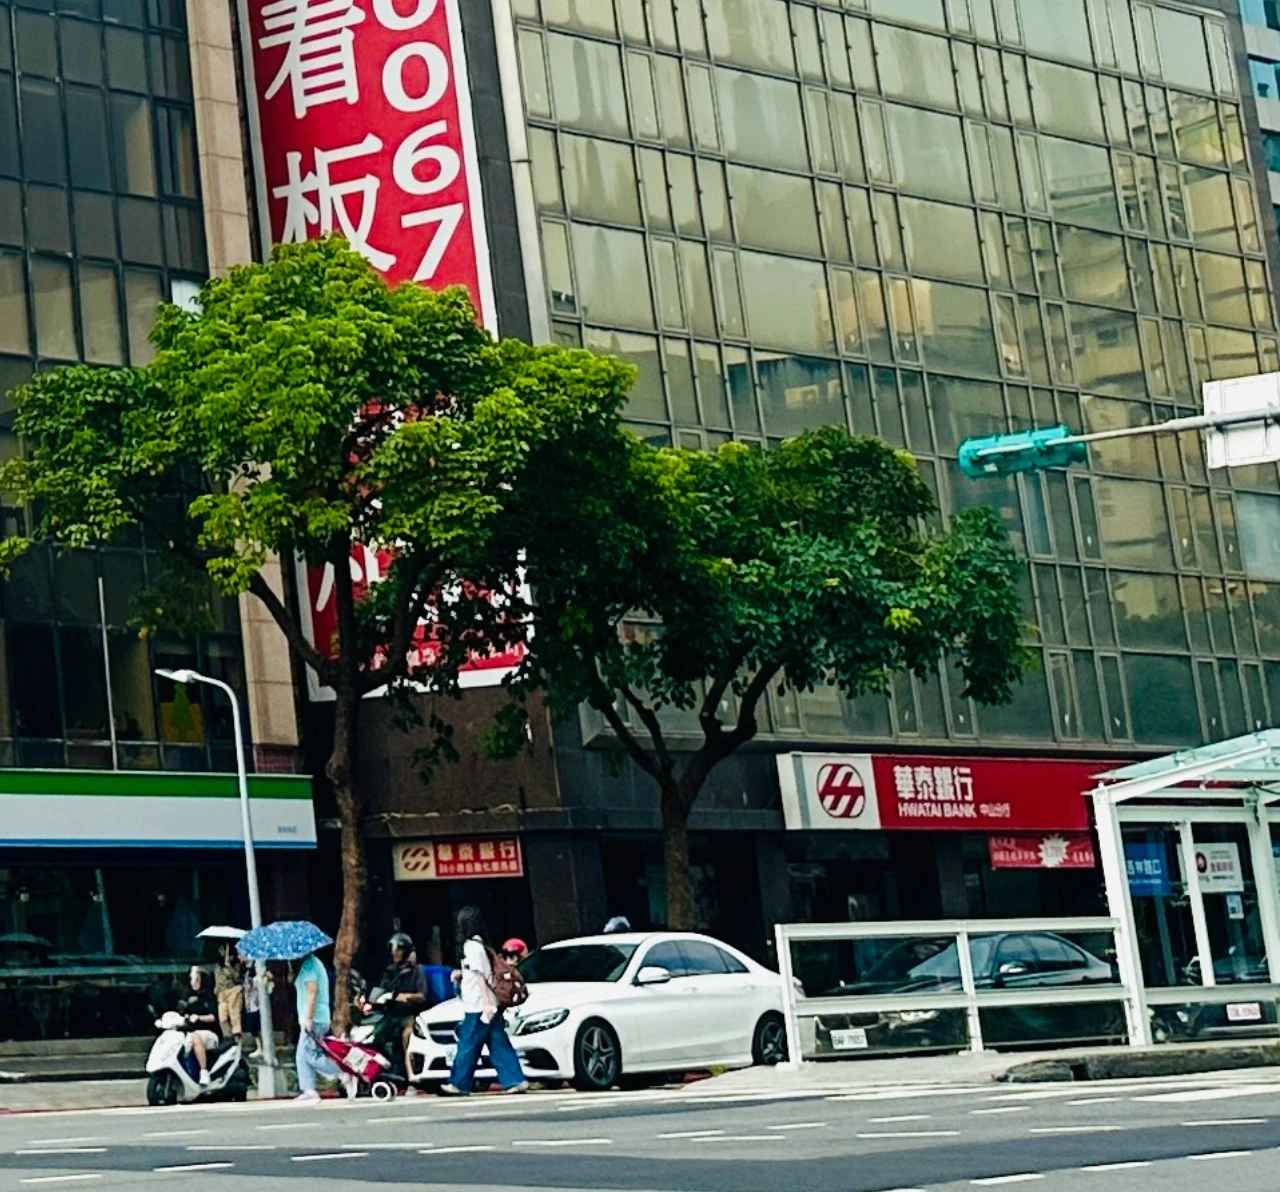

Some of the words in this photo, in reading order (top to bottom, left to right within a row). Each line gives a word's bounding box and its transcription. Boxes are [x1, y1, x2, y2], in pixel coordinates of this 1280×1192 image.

[893, 765, 973, 801] 華泰銀行
[897, 802, 943, 818] HWATAI
[943, 803, 977, 818] BANK
